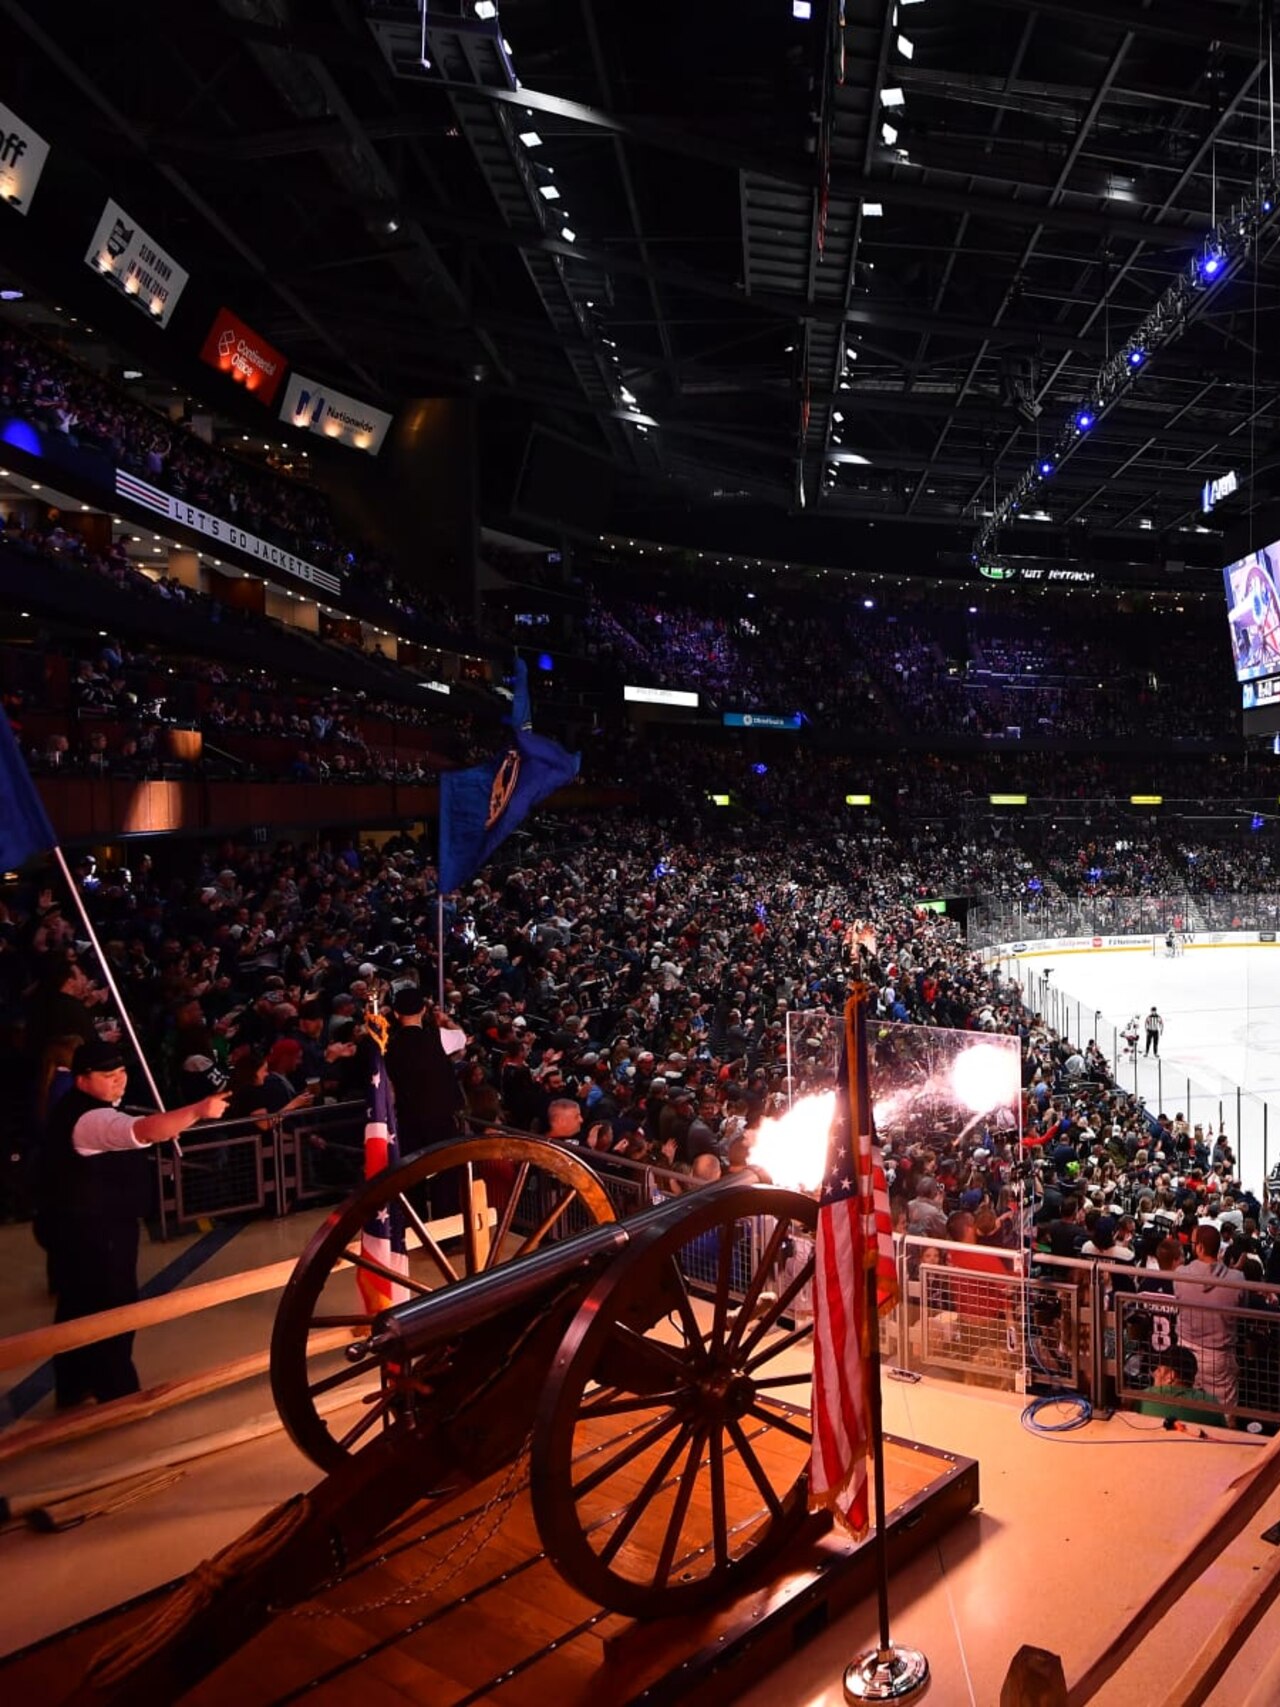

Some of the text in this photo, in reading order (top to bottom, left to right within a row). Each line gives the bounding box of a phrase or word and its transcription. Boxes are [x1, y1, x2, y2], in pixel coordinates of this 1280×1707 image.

[326, 405, 375, 434] Nationwide
[174, 501, 311, 579] LET'S GO JACKETS
[1151, 1315, 1172, 1352] 8
